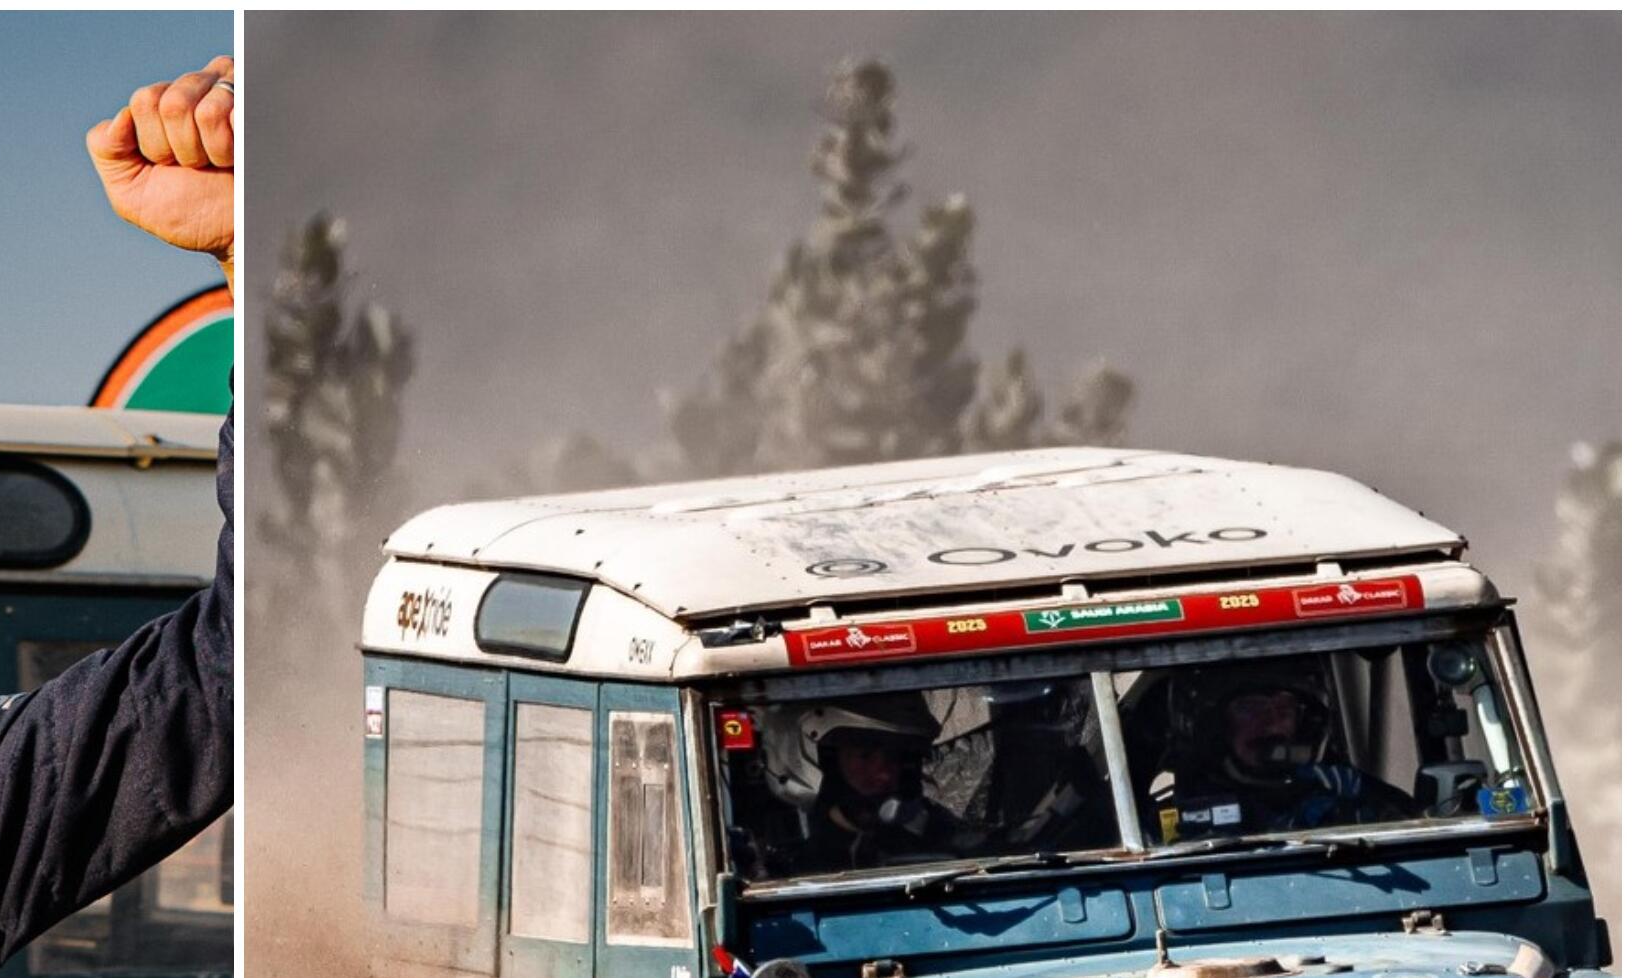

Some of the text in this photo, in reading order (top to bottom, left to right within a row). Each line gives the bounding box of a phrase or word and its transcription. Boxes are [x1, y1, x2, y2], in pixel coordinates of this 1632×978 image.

[928, 526, 1268, 565] Ovoko
[1219, 595, 1259, 609] 2025
[1070, 603, 1169, 619] SAUDI ARABIA
[946, 618, 987, 633] 2025
